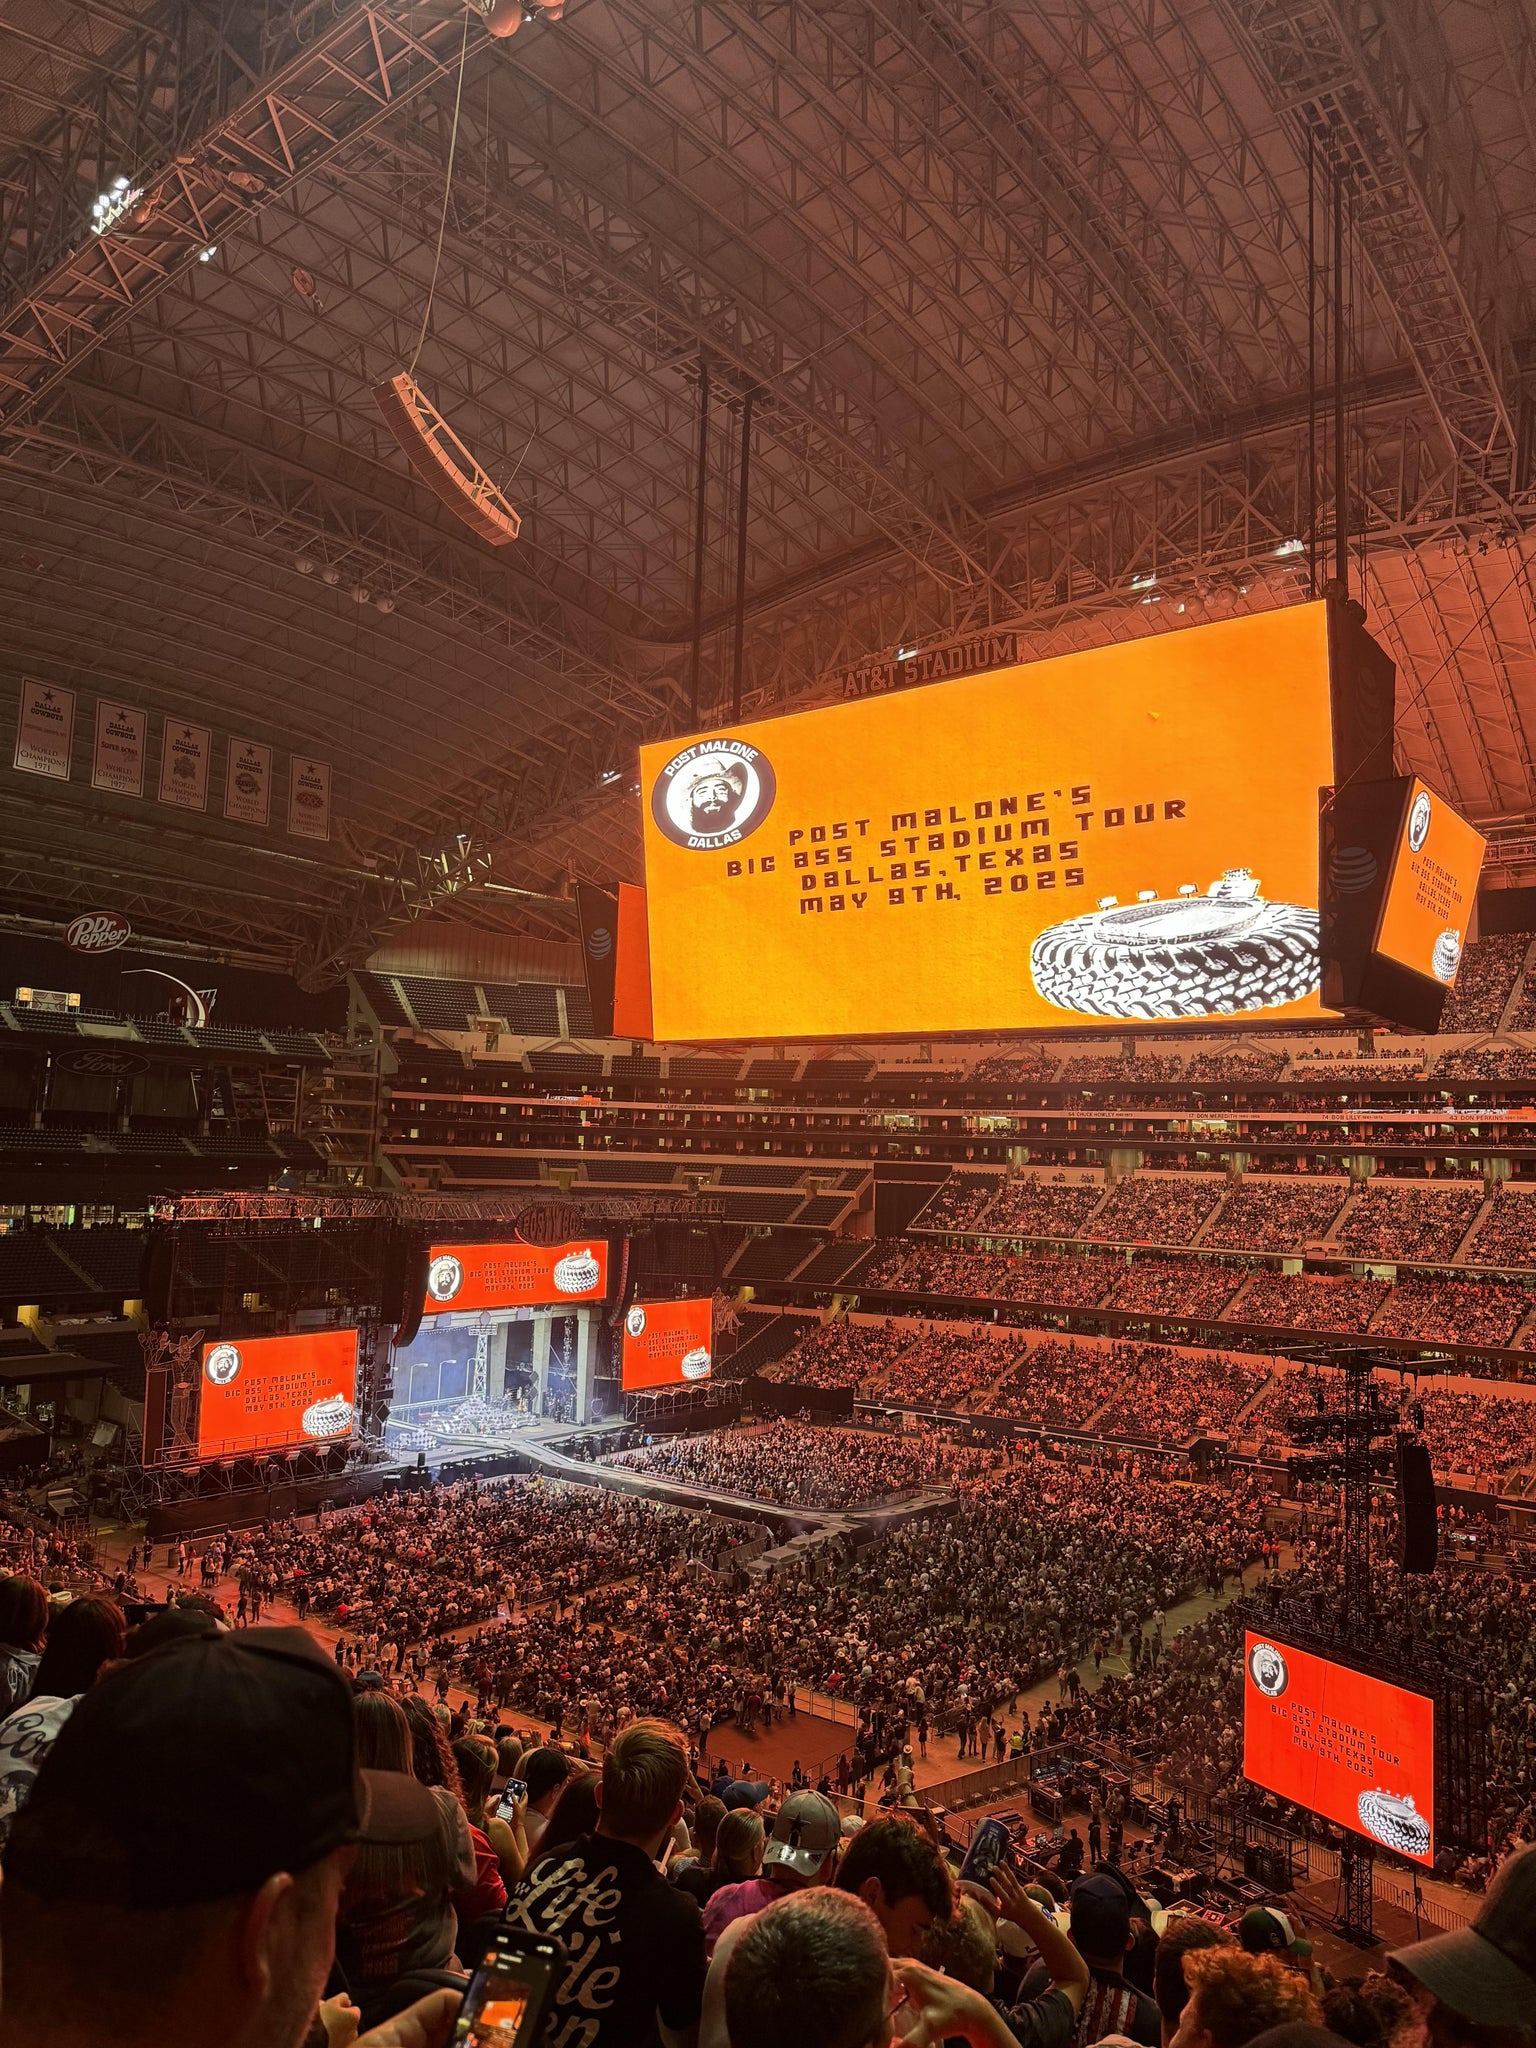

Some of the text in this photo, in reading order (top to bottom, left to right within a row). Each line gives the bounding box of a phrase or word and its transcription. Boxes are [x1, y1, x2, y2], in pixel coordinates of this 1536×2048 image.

[843, 634, 1014, 697] AT&T STADIUM
[31, 708, 63, 721] COWBOYS
[35, 701, 61, 713] DALLAS
[106, 728, 136, 740] COWBOYS
[109, 722, 134, 733] DALLAS
[30, 743, 58, 756] WORLD
[172, 745, 200, 757] COWBOYS
[20, 750, 66, 767] CHAMPIONS
[664, 740, 758, 777] POST MALONE
[34, 761, 51, 772] 1971
[106, 763, 132, 775] WORLD
[98, 769, 139, 784] CHAMPIONS
[172, 778, 196, 790] WORLD
[110, 780, 126, 789] 1977
[164, 784, 203, 800] CHAMPIONS
[229, 800, 266, 814] CHAMPIONS
[236, 795, 259, 806] WORLD
[789, 785, 1091, 846] POST MALONE'S
[688, 828, 742, 848] DALLAS
[727, 800, 1187, 877] BIG ASS STADIUM TOUR
[800, 868, 1084, 914] MAY 9TH, 2025
[93, 917, 117, 932] Dr
[71, 918, 126, 948] Pepper
[73, 1052, 133, 1073] Ford
[226, 1378, 332, 1398] BIG ASS STADIUM TOUR
[244, 1377, 267, 1386] POST
[246, 1404, 264, 1413] MAY
[292, 1398, 312, 1407] 2025
[1292, 1702, 1377, 1744] POST MALONE'S
[1272, 1704, 1400, 1766] BIG ASS STADIUM TOUR
[1294, 1736, 1314, 1752] MAY
[1346, 1760, 1374, 1778] 2025
[506, 1858, 622, 1936] Life
